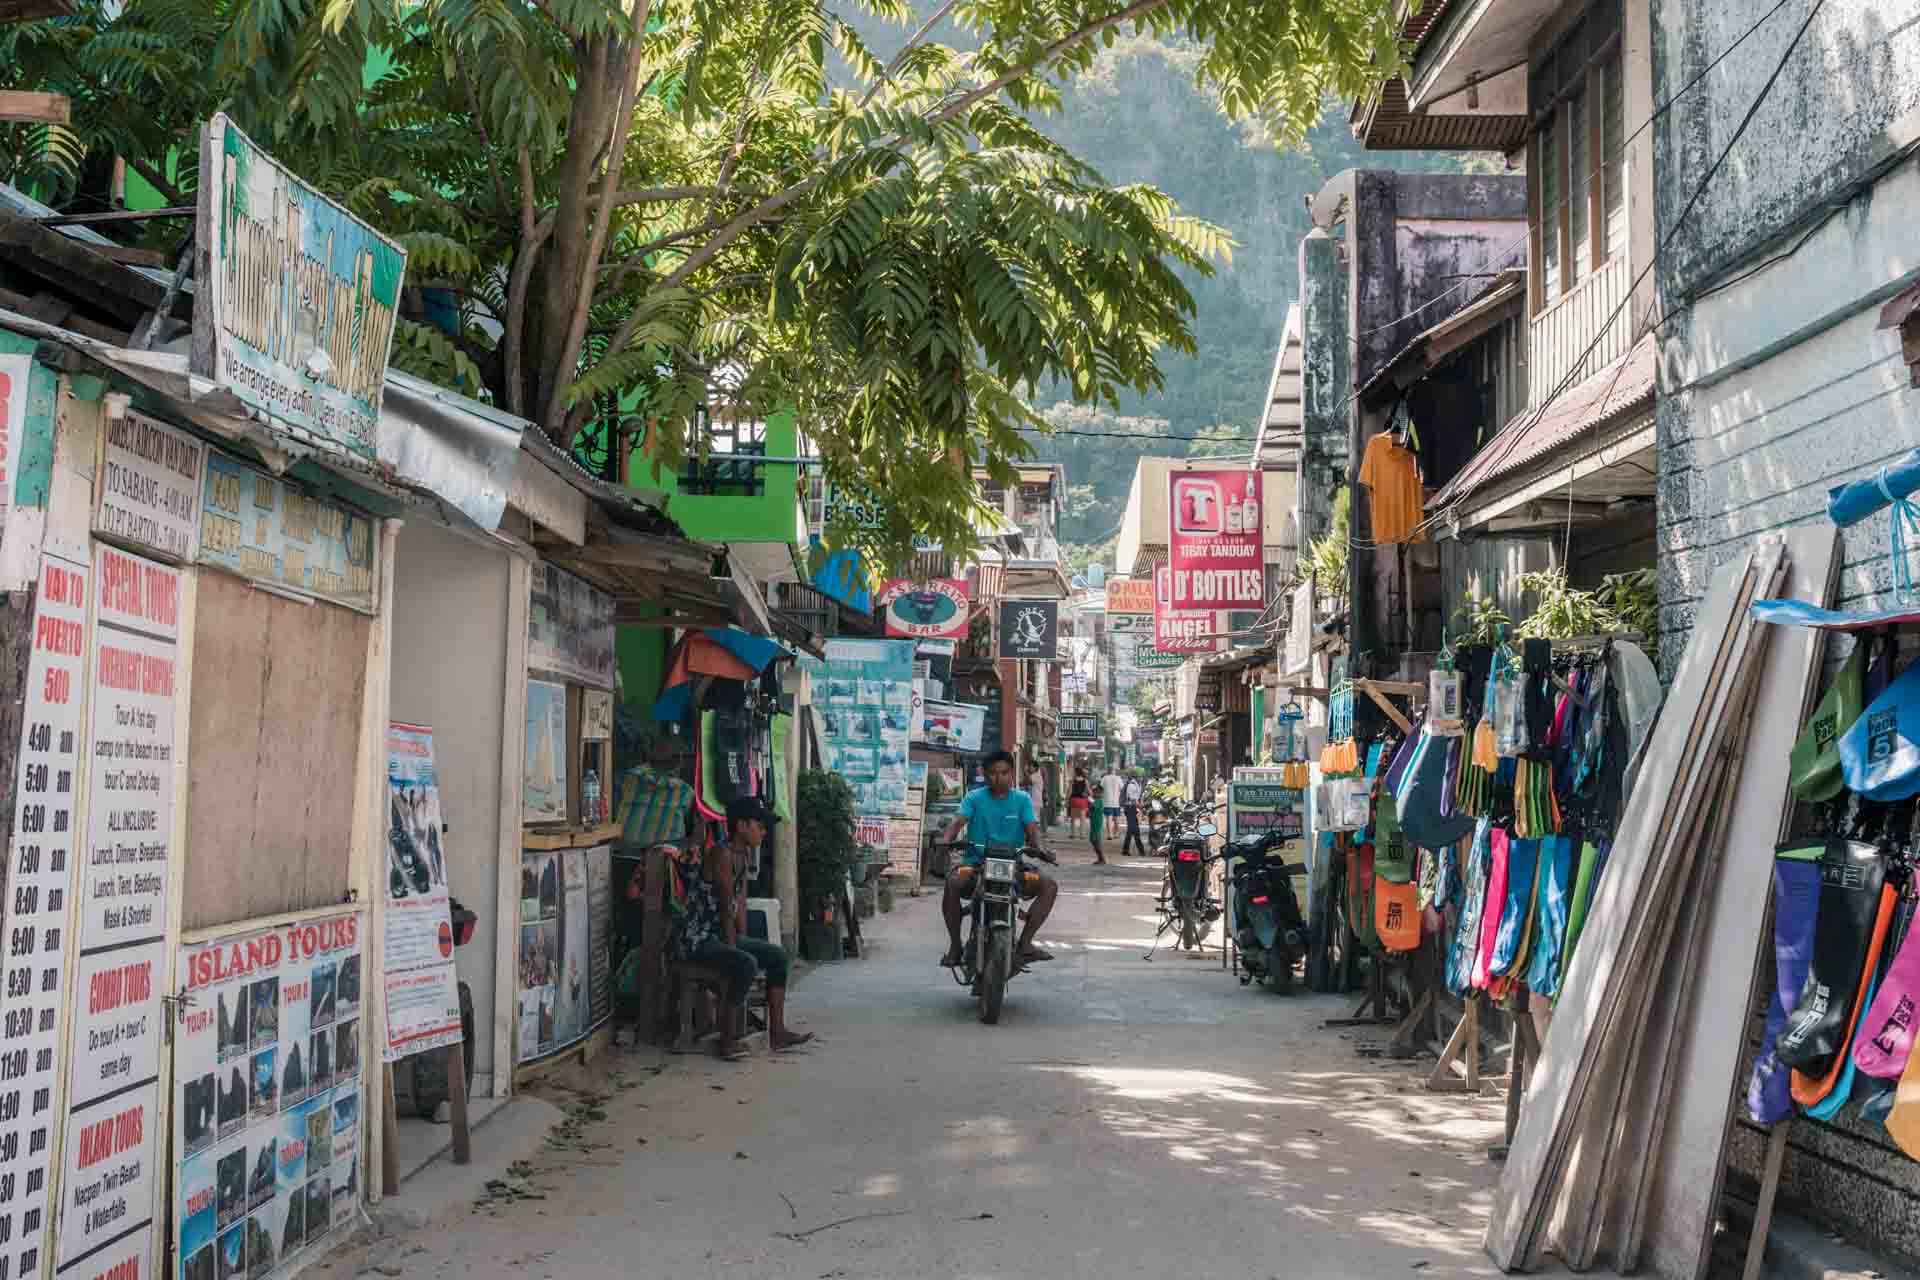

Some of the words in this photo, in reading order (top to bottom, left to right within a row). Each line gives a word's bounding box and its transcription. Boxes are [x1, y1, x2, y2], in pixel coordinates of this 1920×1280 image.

[239, 362, 270, 400] arrange
[108, 461, 121, 493] TO
[121, 467, 158, 509] SABANG
[103, 503, 115, 531] TO
[127, 511, 159, 545] BARTON
[1210, 544, 1256, 558] TANDUAY
[45, 564, 67, 603] VAN
[70, 573, 83, 608] TO
[102, 551, 143, 617] SPECIAL
[144, 565, 177, 626] TOURS
[1192, 570, 1262, 601] BOTTLES
[36, 613, 82, 656] PUERTO
[908, 624, 942, 633] BAR
[1160, 619, 1210, 640] ANGEL
[99, 645, 142, 693] OVERNIGHT
[44, 667, 70, 704] 500
[115, 704, 130, 726] Tour
[130, 707, 136, 727] A
[136, 708, 145, 728] 1st
[146, 710, 157, 735] day
[28, 722, 51, 752] 4:00
[60, 730, 73, 753] am
[95, 740, 114, 764] camp
[115, 741, 124, 759] on
[124, 740, 134, 759] the
[135, 738, 152, 759] beach
[25, 763, 48, 792] 5:00
[57, 770, 71, 792] am
[104, 769, 119, 790] tour
[119, 769, 125, 791] C
[126, 771, 137, 791] and
[138, 769, 149, 791] 2nd
[150, 772, 160, 797] day
[22, 804, 45, 832] 6:00
[53, 809, 68, 832] am
[108, 810, 121, 832] ALL
[18, 845, 40, 874] 7:00
[51, 849, 65, 872] am
[15, 886, 38, 915] 8:00
[48, 888, 63, 912] am
[104, 908, 120, 929] Mask
[121, 906, 127, 928] &
[128, 903, 151, 927] Snorkel
[11, 926, 35, 956] 9:00
[45, 928, 60, 952] am
[188, 935, 283, 989] ISLAND
[287, 915, 358, 961] TOURS
[8, 968, 31, 998] 9:30
[42, 968, 57, 992] am
[89, 967, 122, 1015] COMBO
[123, 960, 152, 1006] TOURS
[4, 1007, 32, 1039] 10:30
[39, 1008, 55, 1032] am
[89, 1029, 98, 1051] Do
[100, 1028, 113, 1048] tour
[114, 1024, 120, 1044] A
[126, 1021, 140, 1040] tour
[140, 1015, 146, 1035] C
[186, 1010, 208, 1037] TOUR
[208, 1006, 214, 1026] A
[1, 1048, 28, 1081] 11:00
[36, 1048, 52, 1072] am
[100, 1060, 118, 1079] same
[119, 1051, 132, 1076] day
[33, 1088, 49, 1116] pm
[30, 1128, 46, 1157] pm
[79, 1118, 114, 1169] INLAND
[114, 1104, 144, 1153] TOURS
[26, 1168, 43, 1198] pm
[74, 1180, 101, 1209] Nacpan
[103, 1173, 118, 1193] Twin
[120, 1159, 140, 1187] Beach
[22, 1208, 40, 1239] pm
[85, 1213, 91, 1235] &
[93, 1196, 126, 1232] Waterfalls
[20, 1248, 37, 1278] pm
